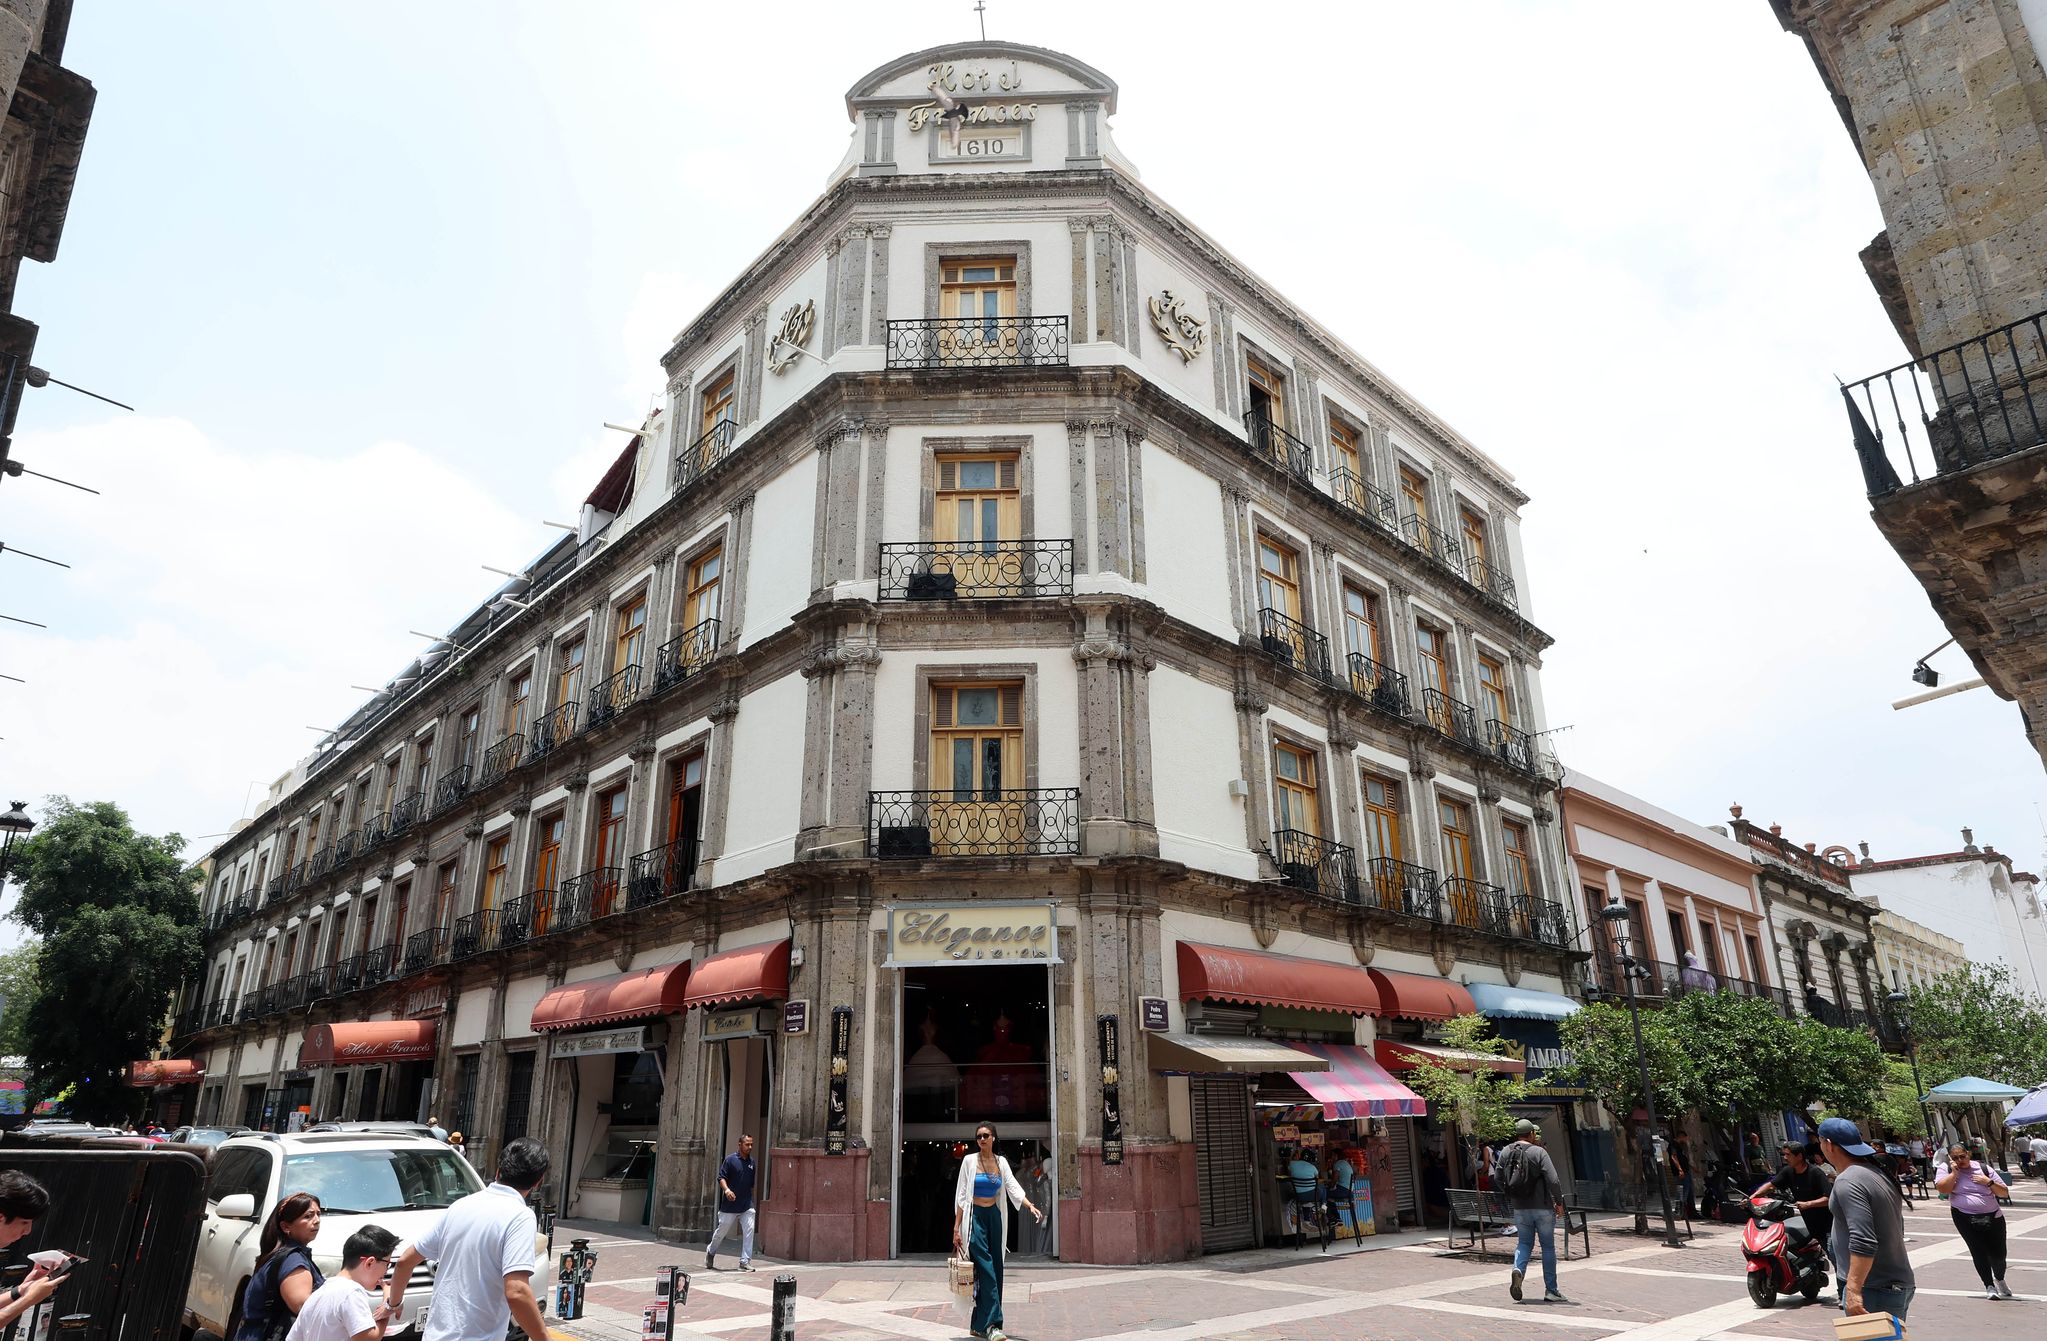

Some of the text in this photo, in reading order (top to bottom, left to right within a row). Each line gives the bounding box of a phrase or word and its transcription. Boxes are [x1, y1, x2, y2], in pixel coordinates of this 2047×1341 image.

[908, 101, 1038, 132] Frnces
[899, 911, 1047, 953] Elegance
[408, 985, 443, 1015] HOTEL
[342, 1041, 383, 1056] Hotel
